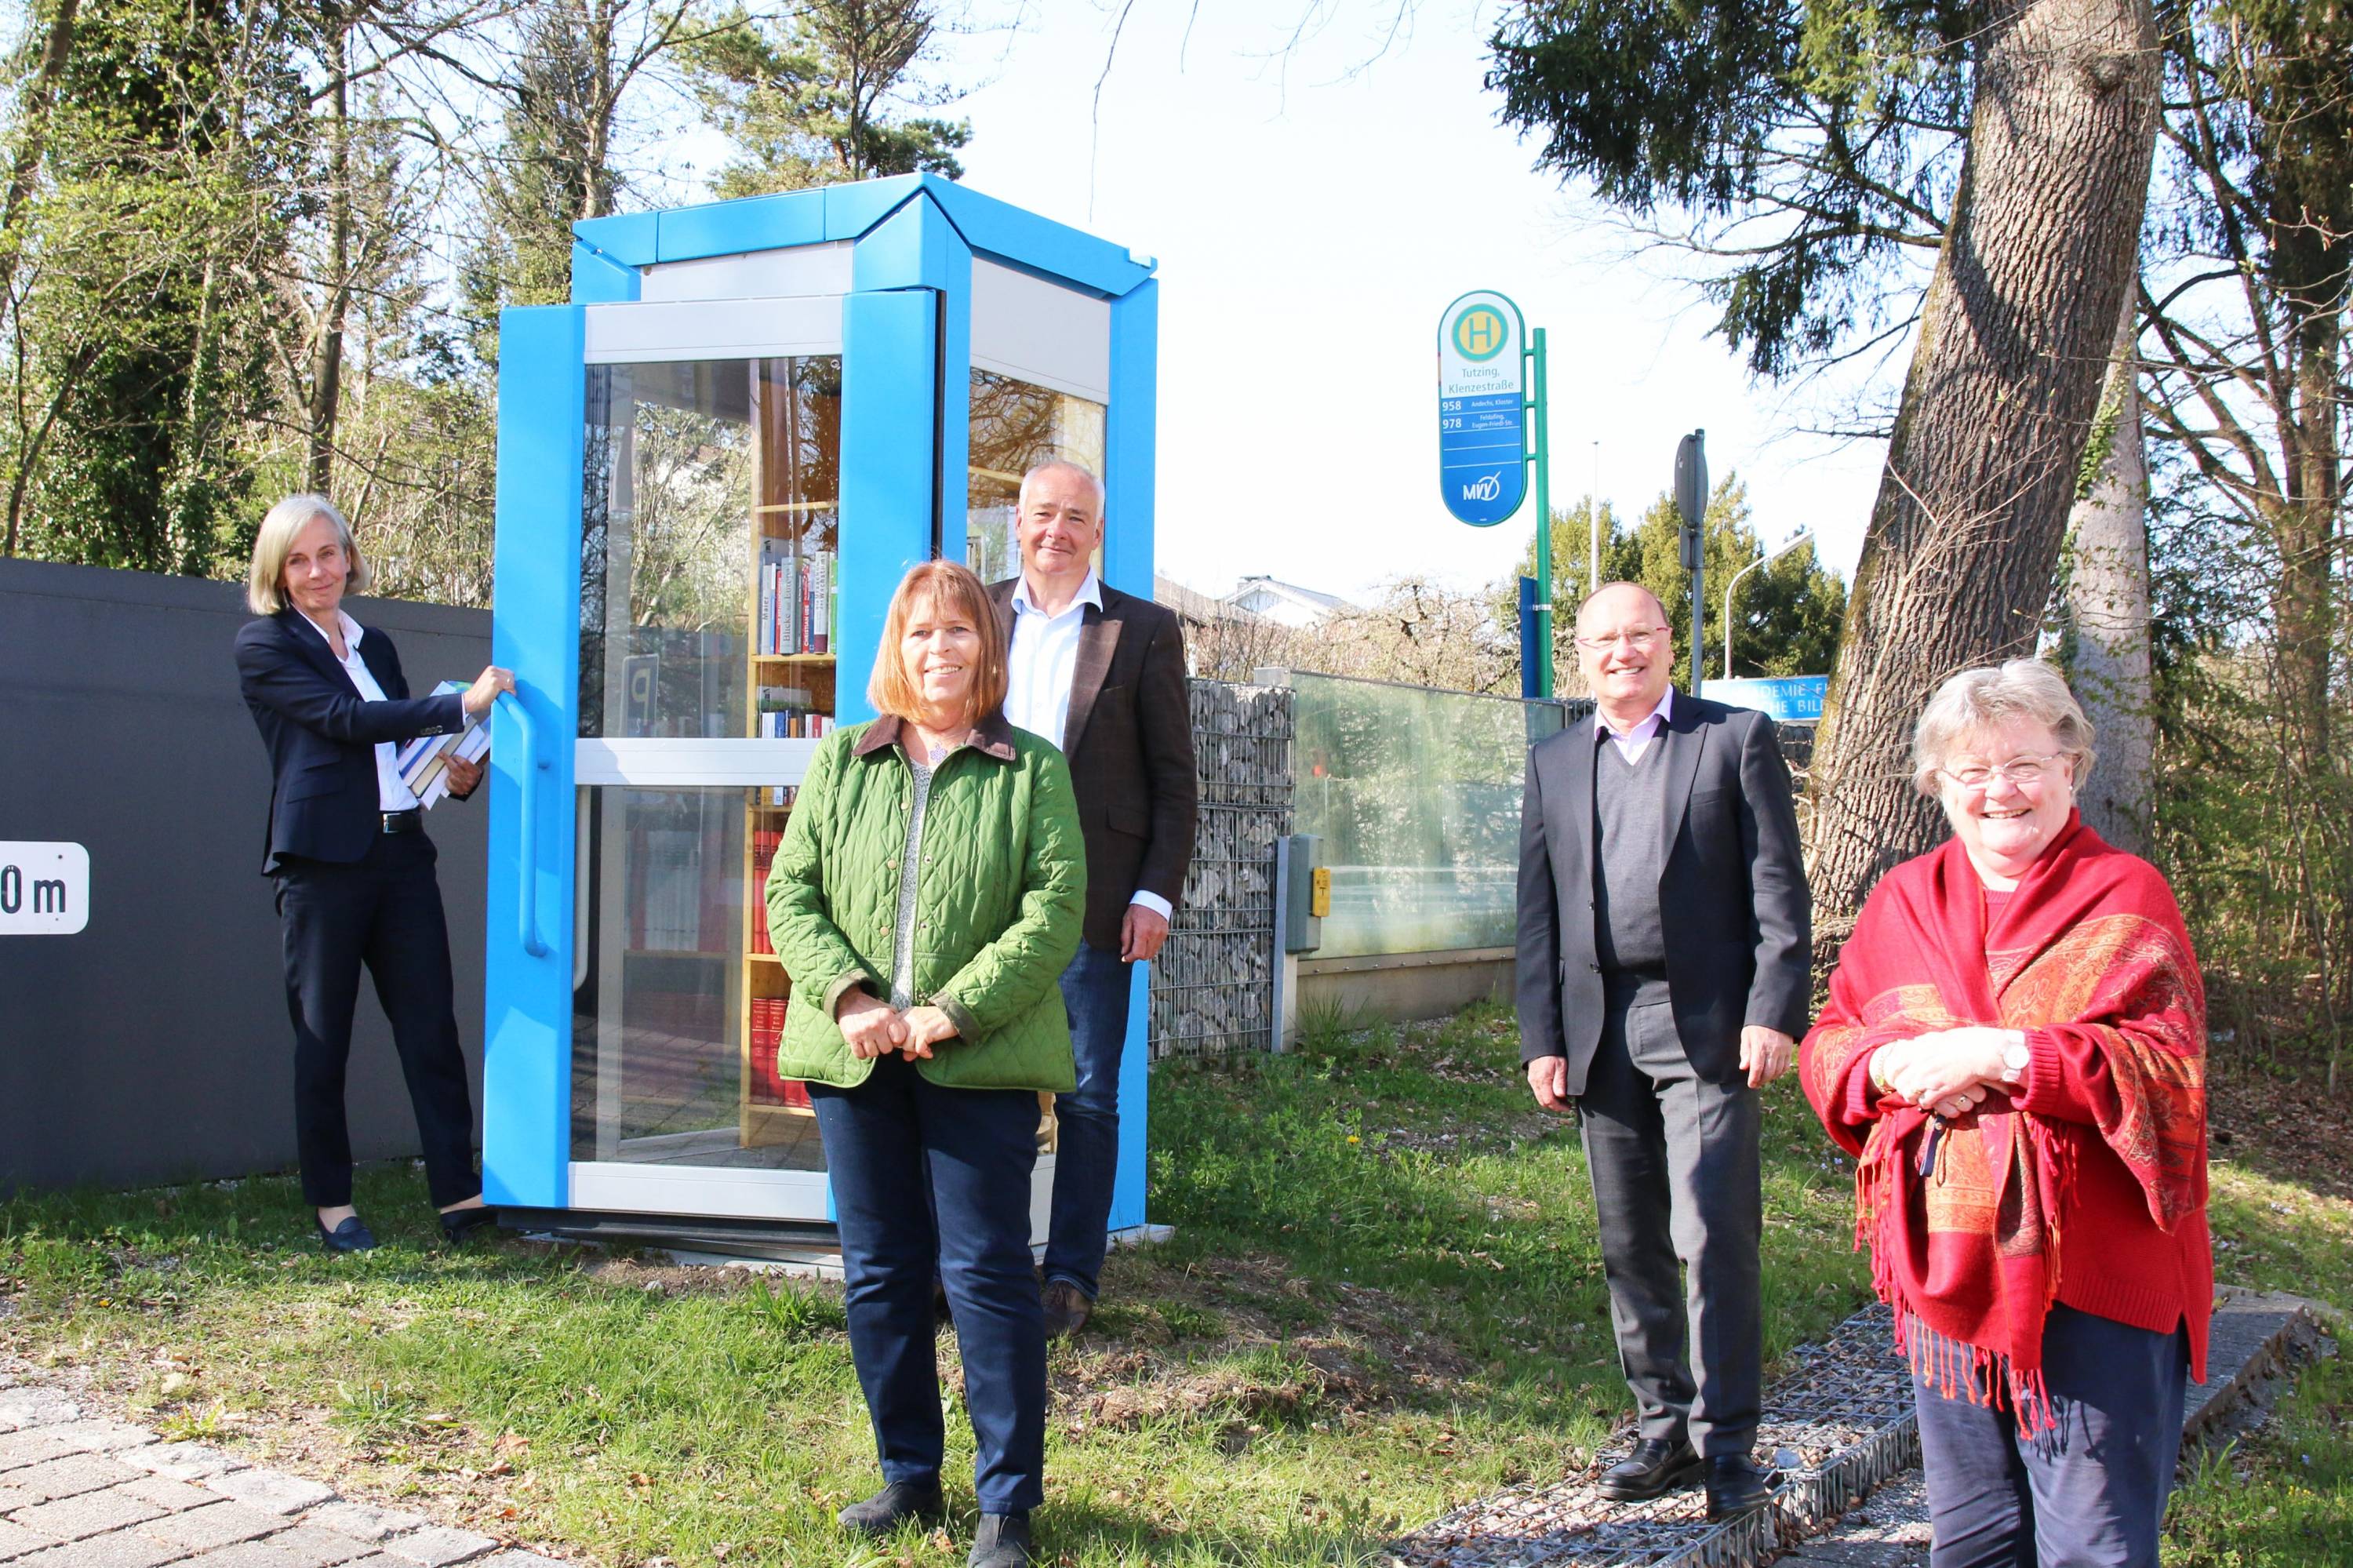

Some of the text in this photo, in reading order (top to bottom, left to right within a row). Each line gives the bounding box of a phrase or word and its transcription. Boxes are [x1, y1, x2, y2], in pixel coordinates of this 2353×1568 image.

[1469, 316, 1491, 349] H
[1462, 366, 1500, 378] Tutzing,
[1449, 380, 1514, 394] Klenzestraße
[1442, 400, 1461, 411] 958
[1442, 418, 1462, 429] 978
[783, 614, 791, 642] Blicke
[34, 879, 66, 913] m
